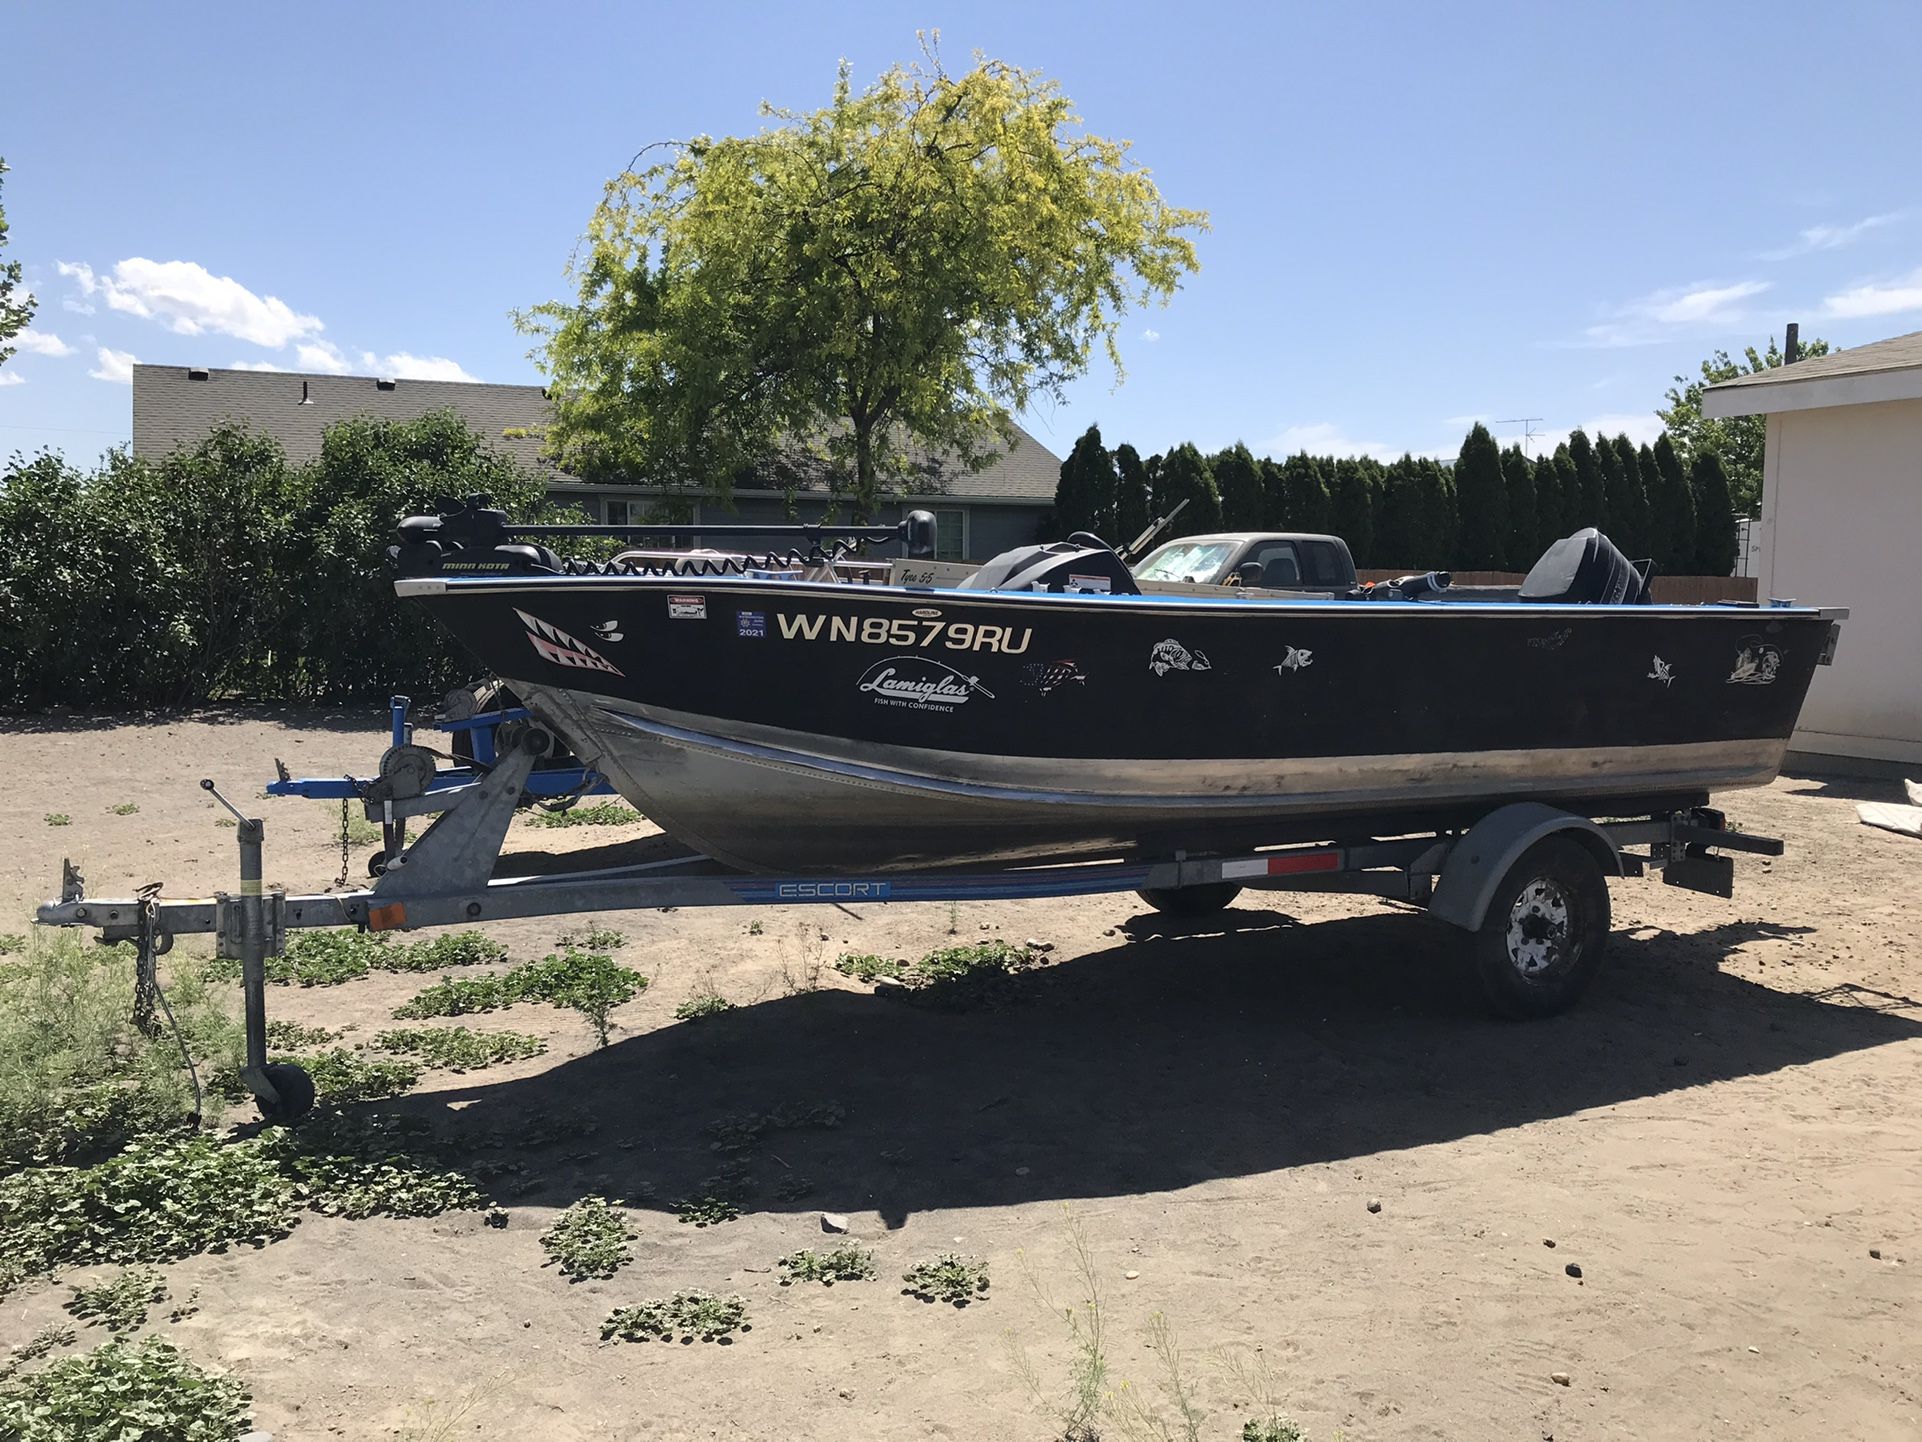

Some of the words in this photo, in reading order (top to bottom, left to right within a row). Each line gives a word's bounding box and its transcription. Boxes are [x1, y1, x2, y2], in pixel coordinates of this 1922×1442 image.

[739, 629, 764, 637] 2021
[776, 613, 1033, 654] WN8579RU
[859, 667, 970, 703] Lamiglas
[874, 697, 889, 705] FISH
[890, 699, 907, 707] WITH
[908, 701, 954, 713] CONFIDENCE
[780, 882, 886, 897] ESCORT
